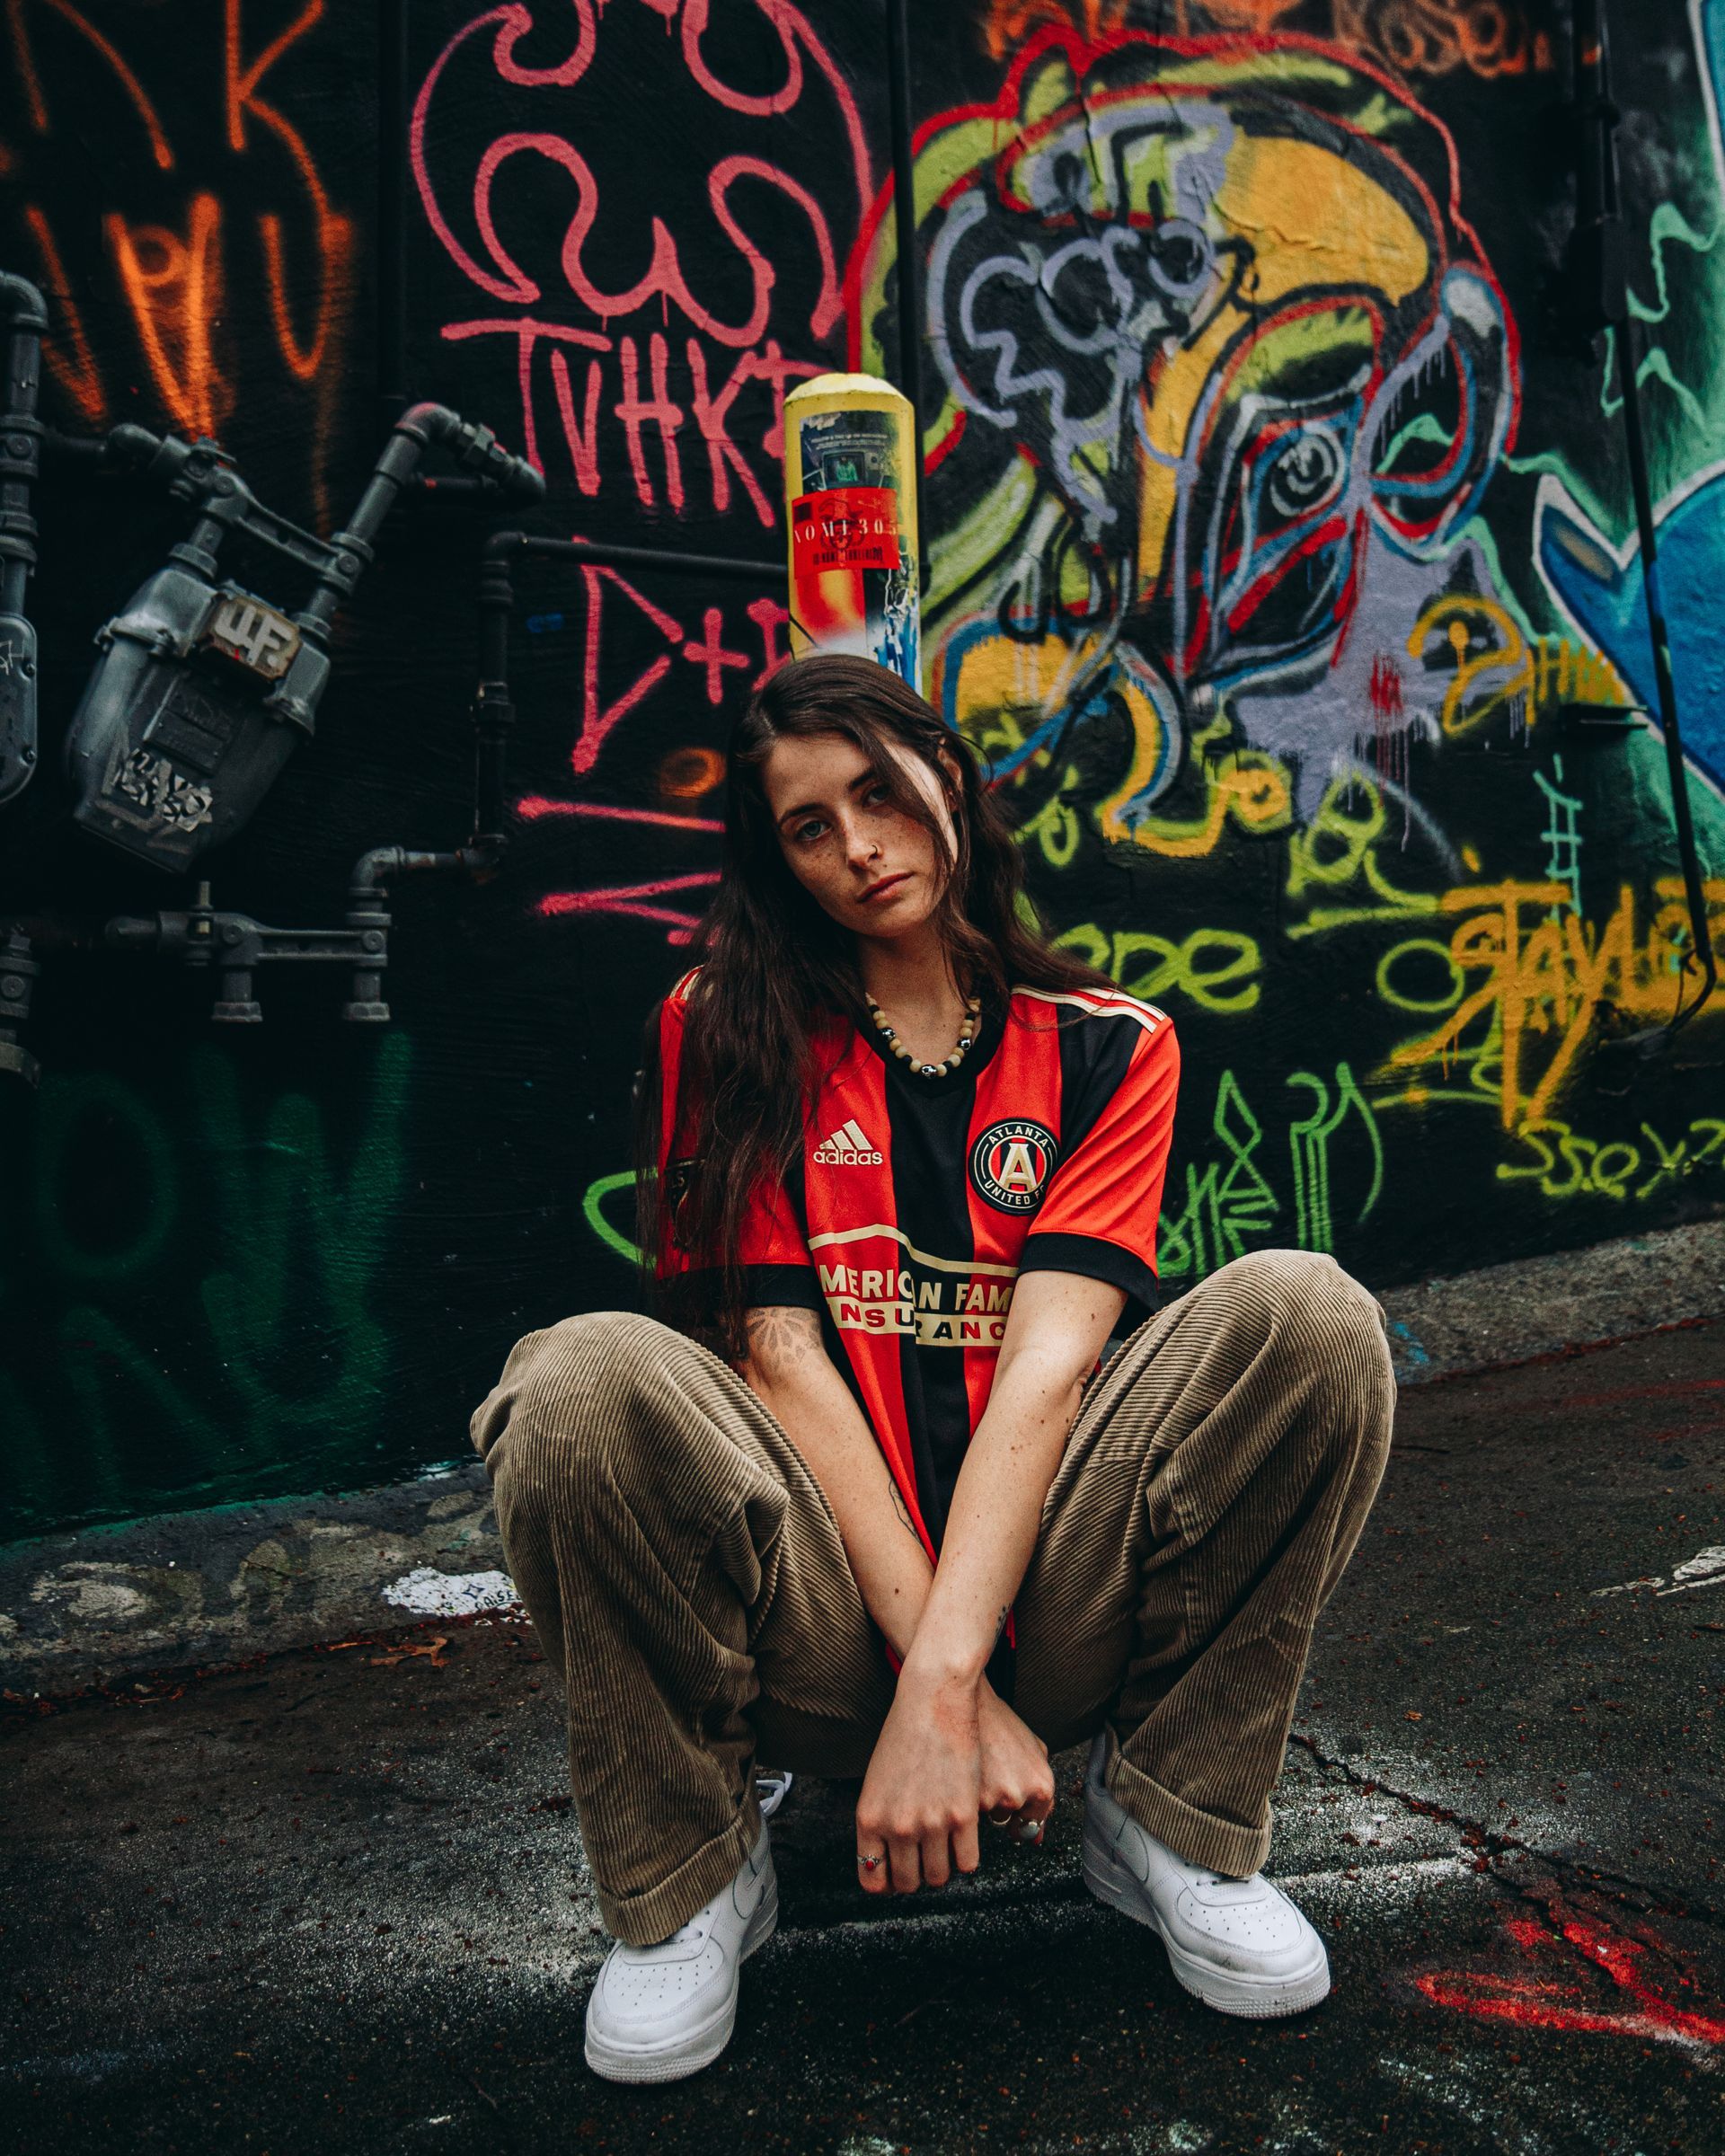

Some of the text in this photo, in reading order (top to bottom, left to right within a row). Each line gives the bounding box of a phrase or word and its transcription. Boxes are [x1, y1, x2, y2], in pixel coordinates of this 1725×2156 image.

[988, 1126, 1049, 1147] ATLANTA
[812, 1148, 883, 1166] adidas
[998, 1143, 1038, 1192] A
[985, 1180, 1031, 1205] UNITED
[818, 1263, 1013, 1312] MERICN FAM
